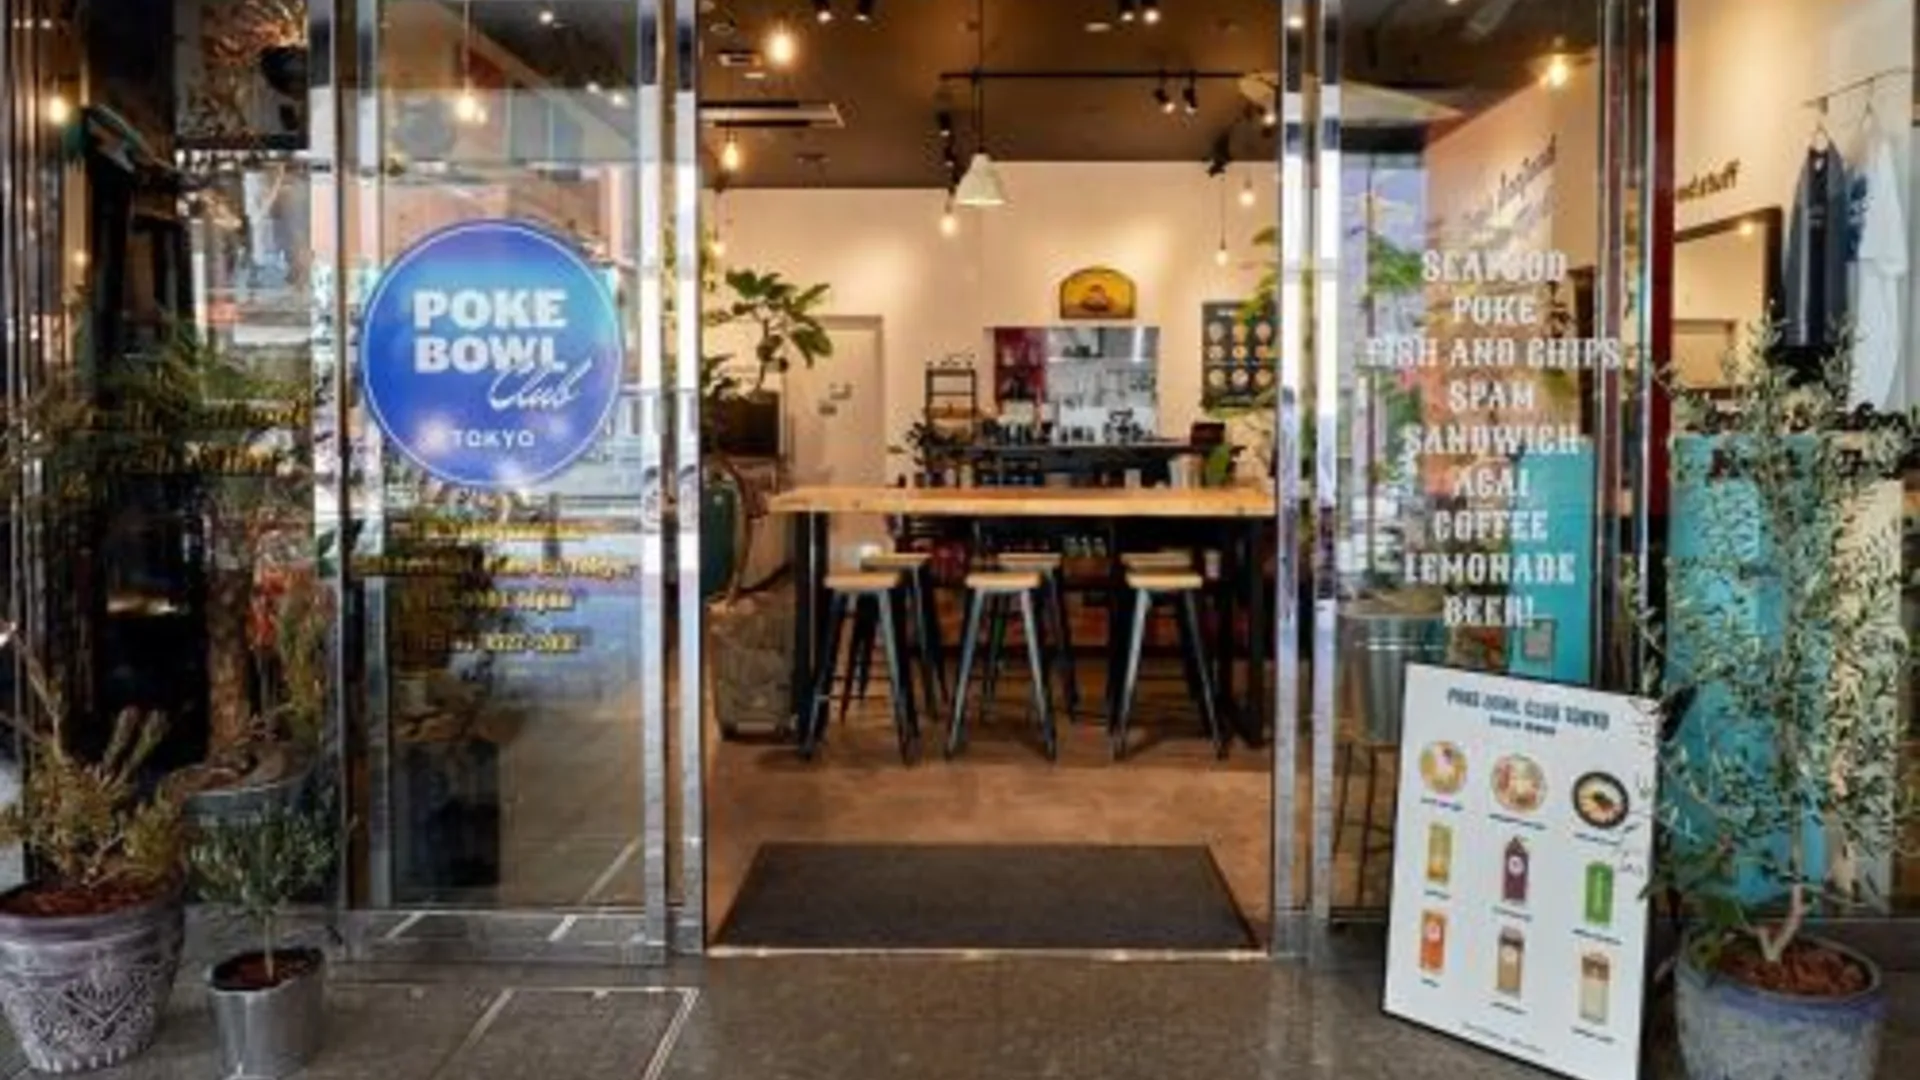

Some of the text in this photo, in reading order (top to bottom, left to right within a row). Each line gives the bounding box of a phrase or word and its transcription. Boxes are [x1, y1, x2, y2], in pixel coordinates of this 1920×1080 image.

[1421, 250, 1567, 283] SEAFOOD
[414, 289, 568, 330] POKE
[1454, 296, 1538, 326] POKE
[414, 336, 568, 374] BOWL
[1367, 337, 1621, 368] FISH AND CHIPS
[488, 357, 593, 411] Club
[1450, 380, 1535, 412] SPAM
[451, 429, 535, 447] TOKYO
[1403, 424, 1580, 454] SANDWICH
[1433, 510, 1549, 542] COFFEE
[1404, 552, 1576, 583] LEMONADE
[1444, 596, 1535, 627] BEER!
